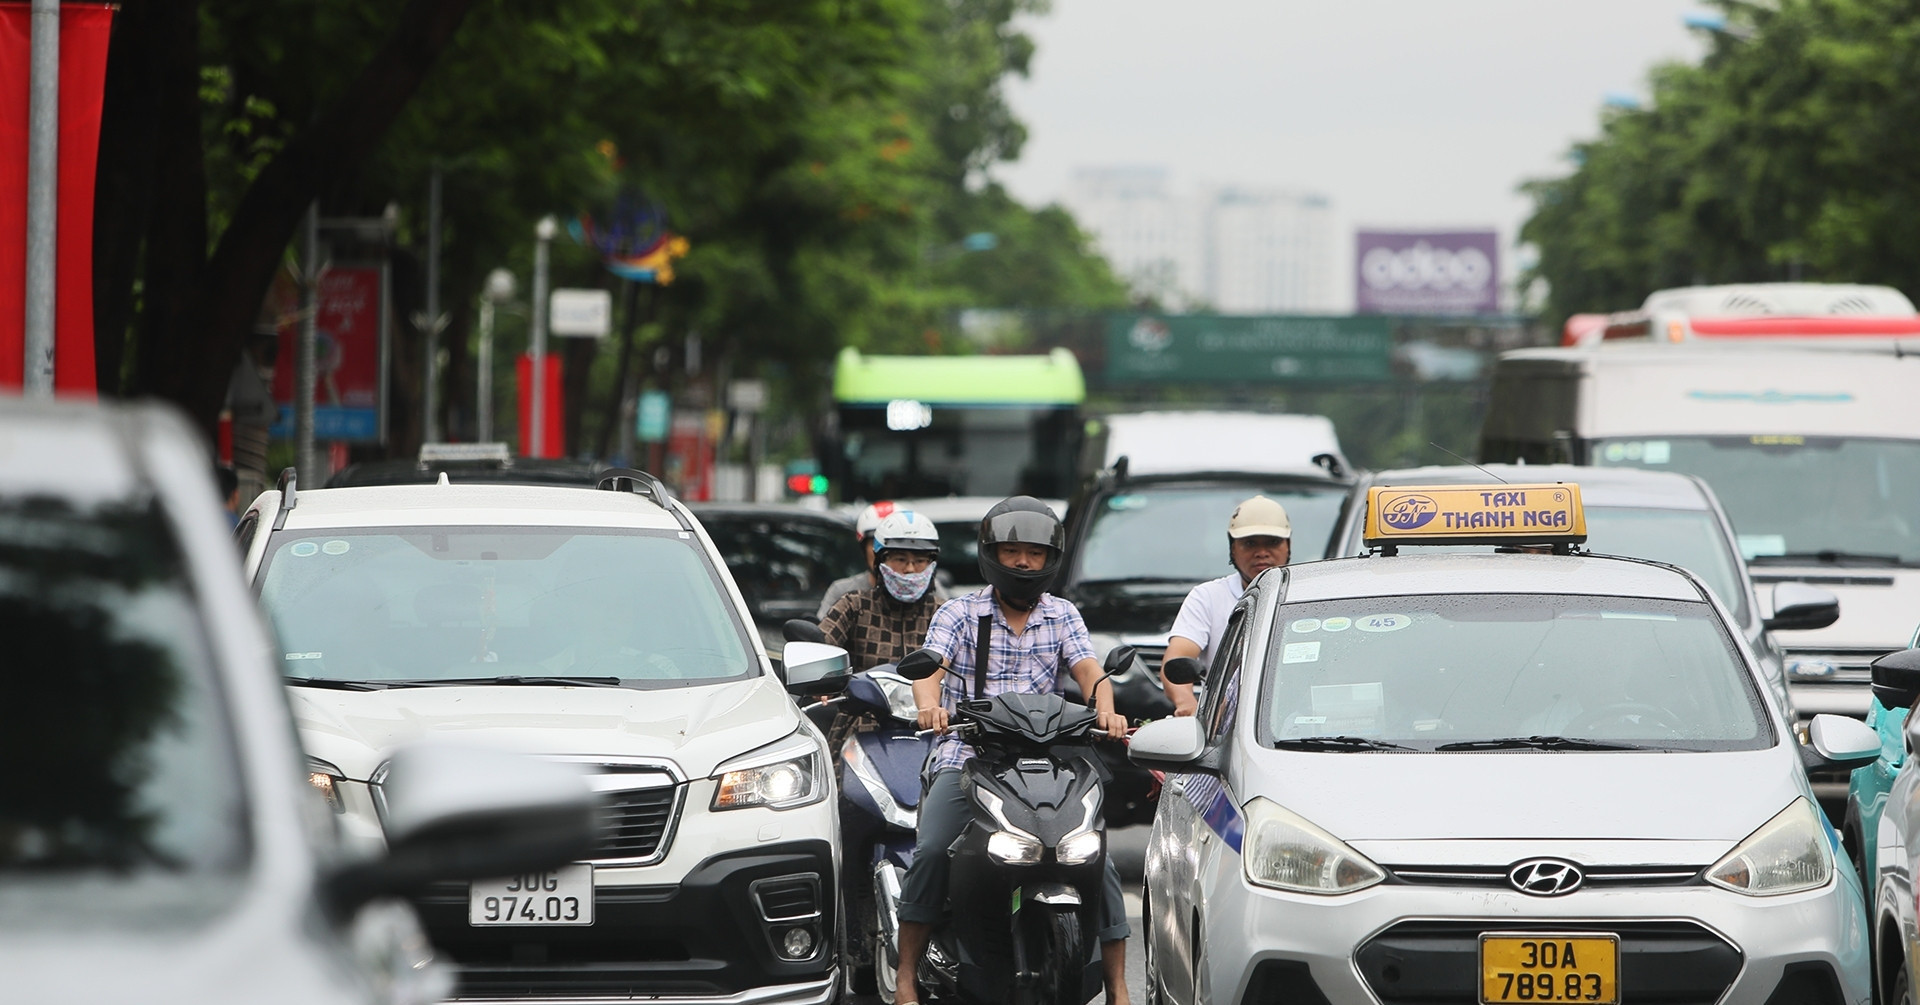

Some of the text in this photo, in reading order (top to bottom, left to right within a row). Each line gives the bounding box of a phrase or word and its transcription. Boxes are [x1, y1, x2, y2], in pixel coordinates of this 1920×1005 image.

[1480, 492, 1526, 508] TAXI
[1442, 510, 1567, 529] THANH NGA
[1369, 617, 1396, 627] 45
[484, 896, 579, 921] 974.03
[1521, 941, 1577, 968] 30A
[1497, 973, 1602, 1000] 789.83
